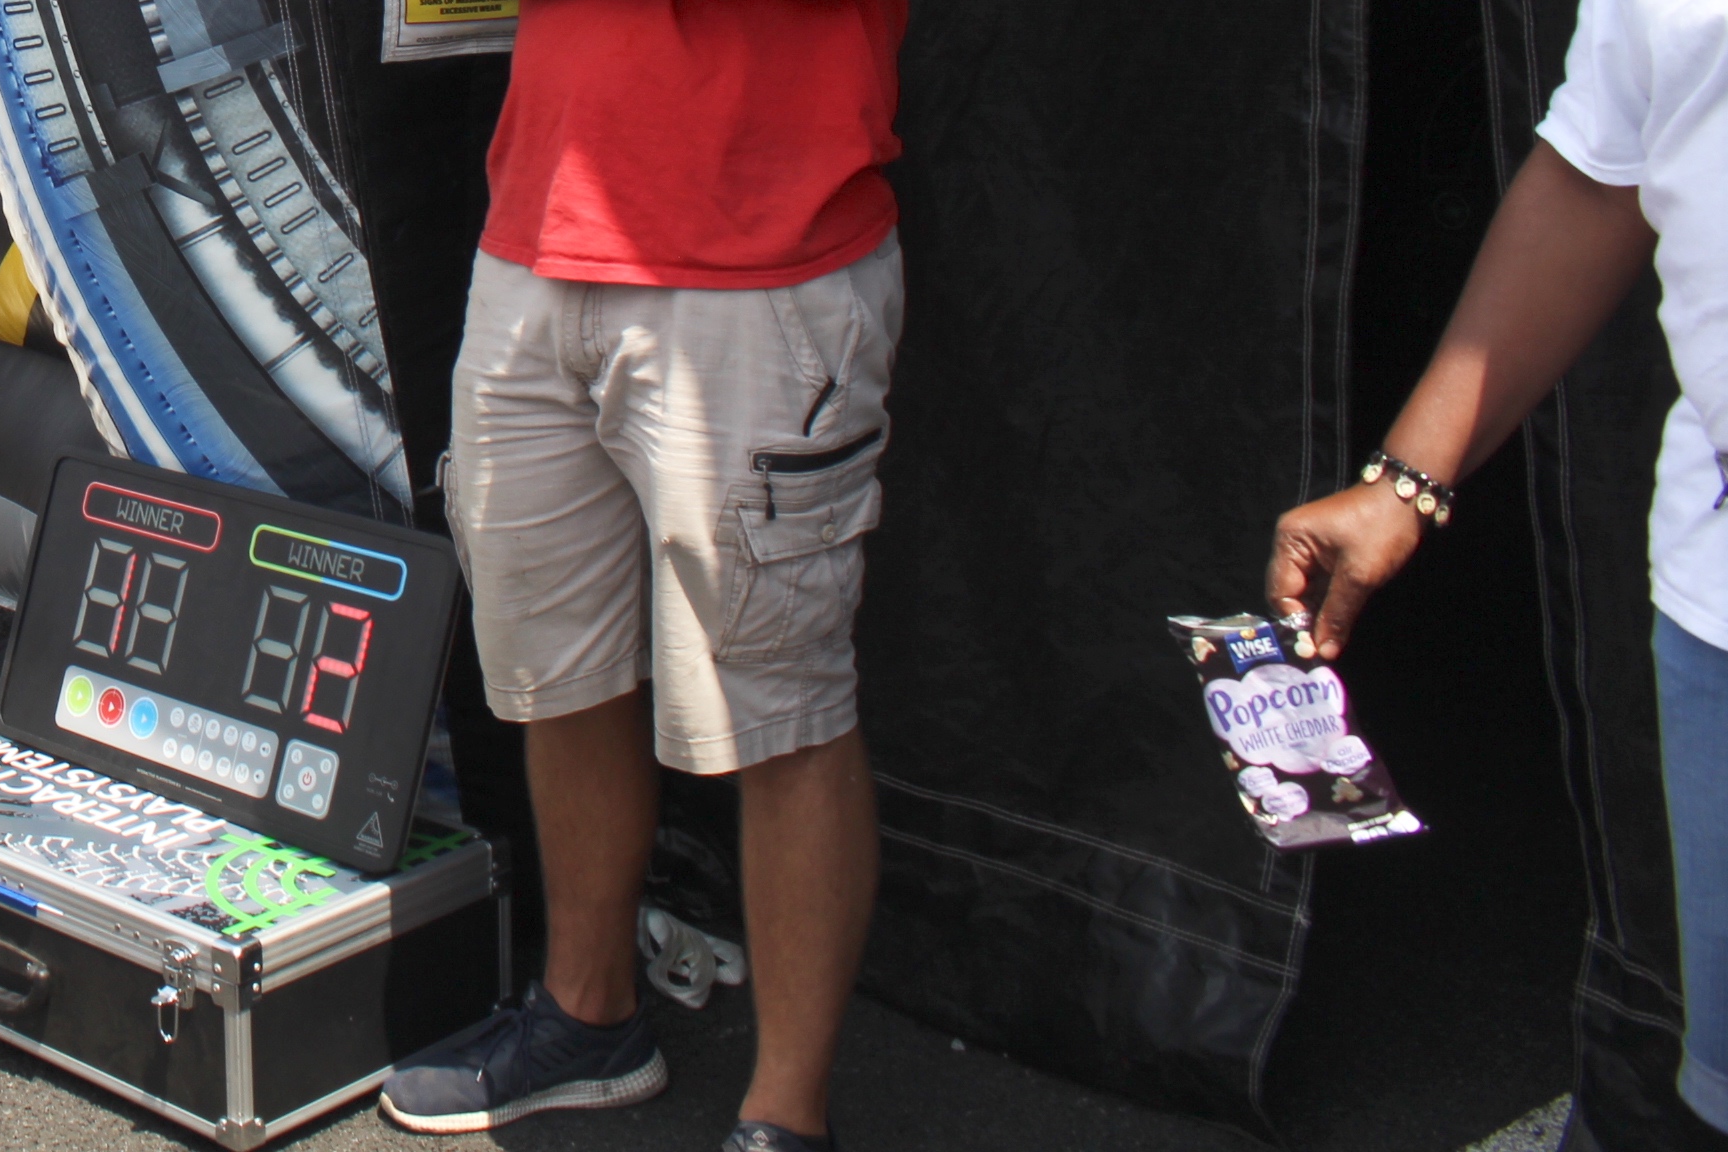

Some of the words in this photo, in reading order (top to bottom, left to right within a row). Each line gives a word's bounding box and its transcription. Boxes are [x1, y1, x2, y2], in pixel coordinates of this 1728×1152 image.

[116, 497, 184, 535] WINNER
[288, 542, 365, 583] WINNER
[1230, 636, 1278, 660] WISE
[1207, 678, 1340, 733] Popcorn
[1238, 727, 1284, 753] WHITE
[1286, 714, 1340, 746] CHEDDAR
